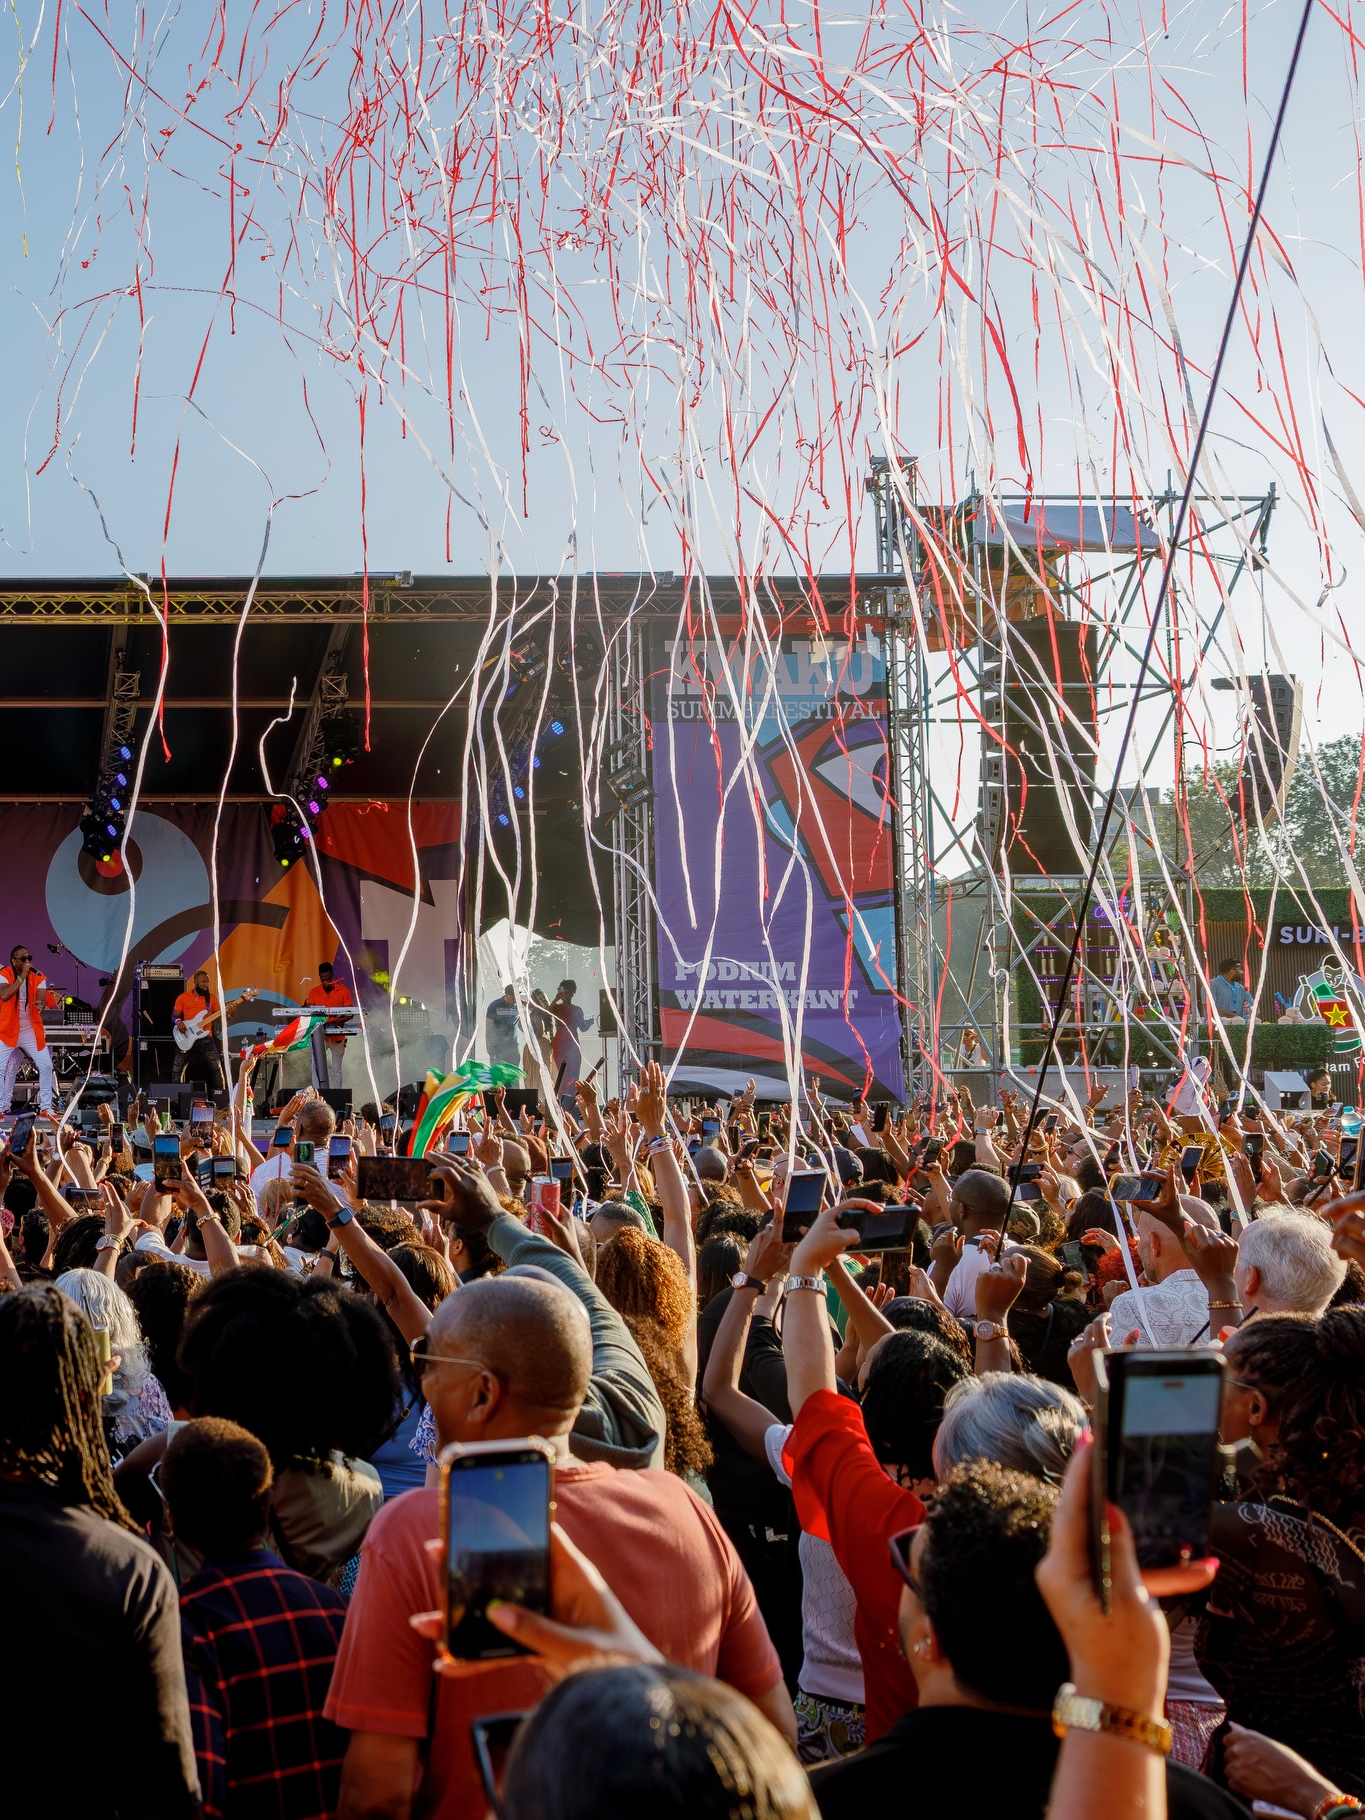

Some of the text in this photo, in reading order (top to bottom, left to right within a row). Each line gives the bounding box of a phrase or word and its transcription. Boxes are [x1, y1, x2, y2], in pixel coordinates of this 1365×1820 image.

[664, 640, 882, 695] KWAKU
[675, 961, 796, 981] PODIUM
[674, 989, 858, 1009] WATERKANT
